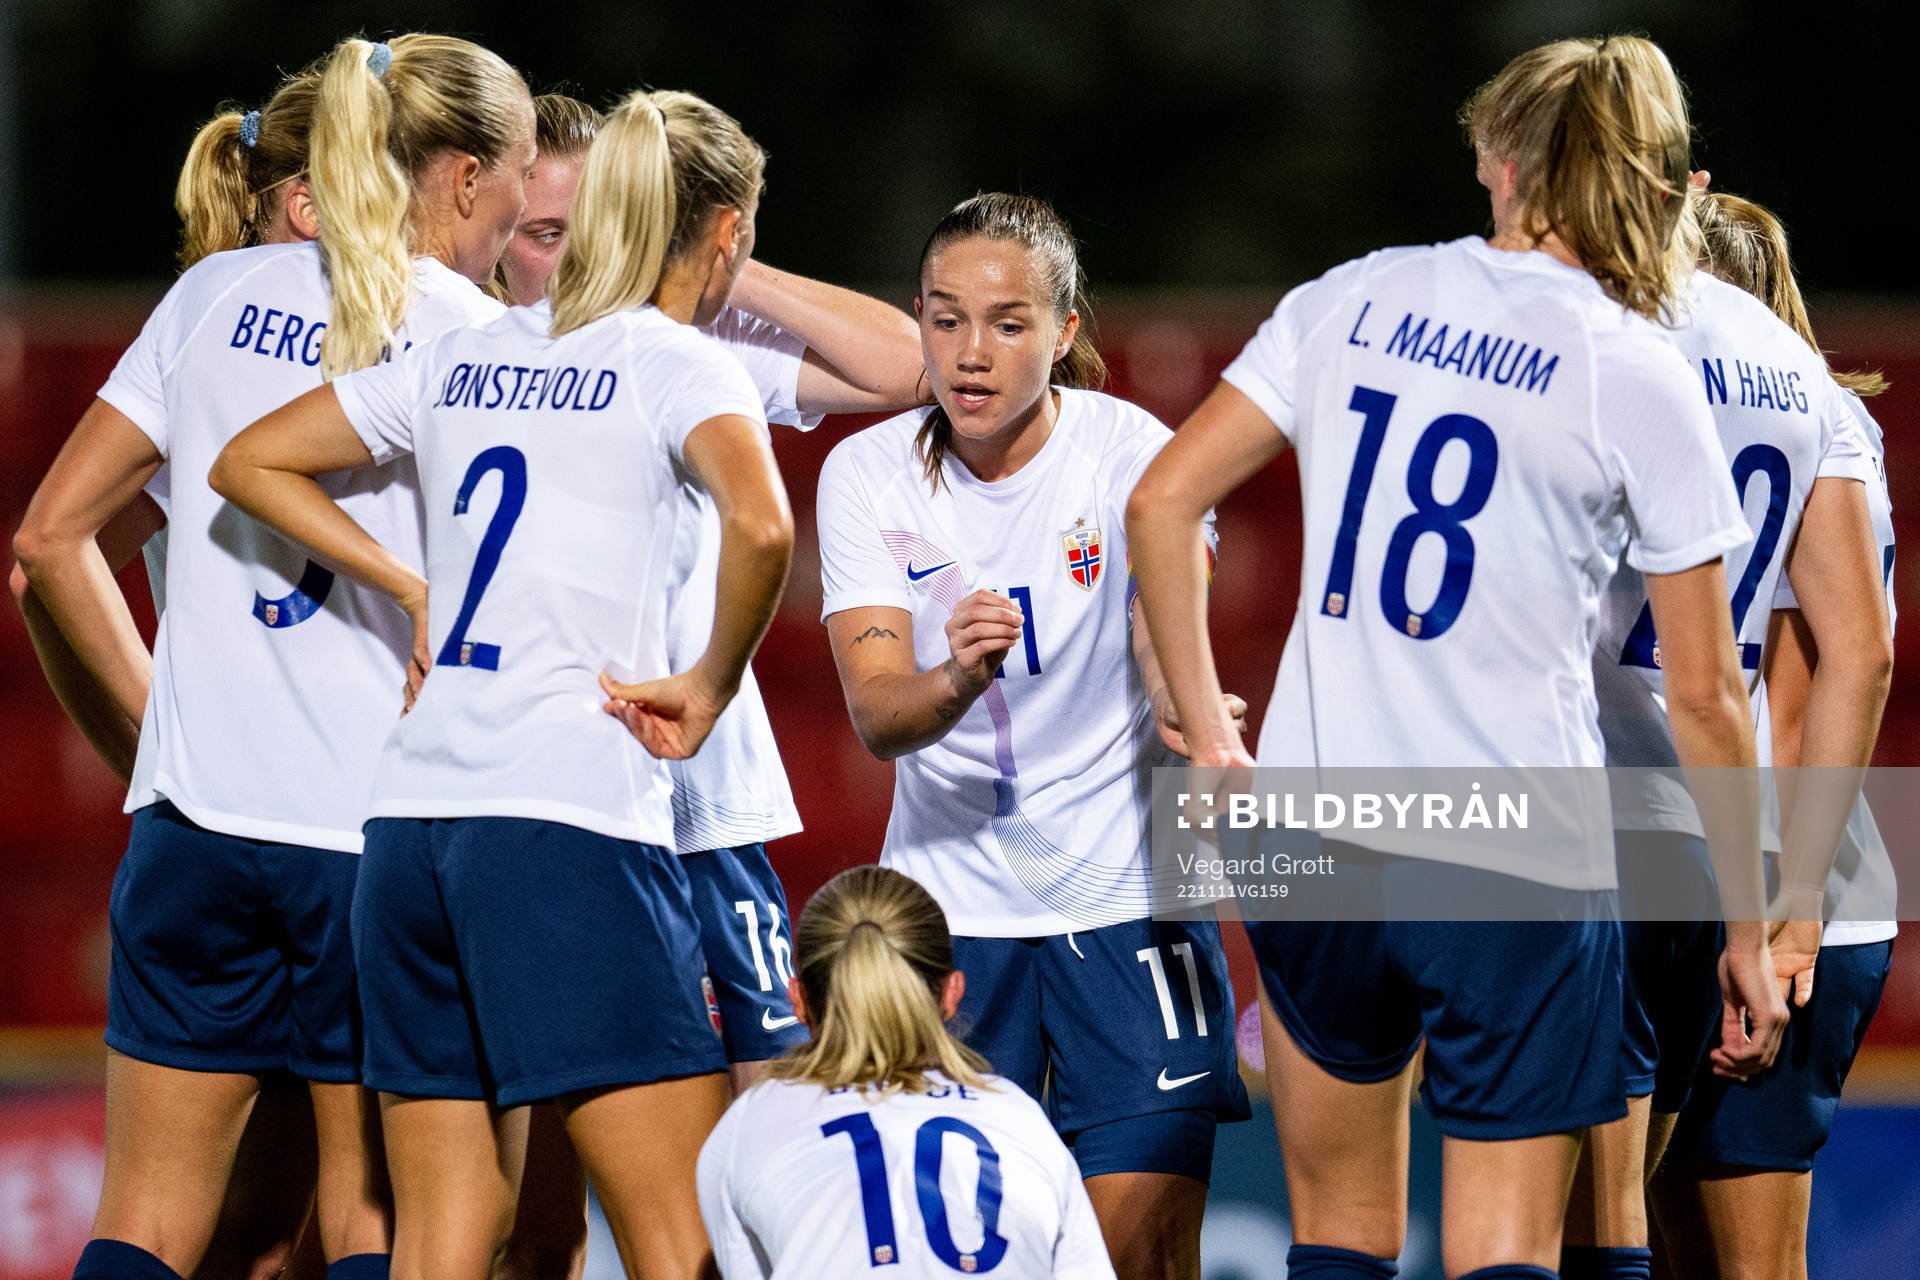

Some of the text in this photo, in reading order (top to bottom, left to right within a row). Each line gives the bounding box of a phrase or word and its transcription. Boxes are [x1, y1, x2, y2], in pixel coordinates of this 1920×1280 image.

[230, 304, 330, 367] BERG
[1348, 300, 1560, 395] L. MAANUM
[1699, 357, 1809, 415] N HAUG
[436, 445, 528, 672] 2
[1320, 384, 1499, 641] 18
[735, 900, 796, 992] 16
[1136, 942, 1208, 1040] 11
[820, 1112, 1009, 1275] 10
